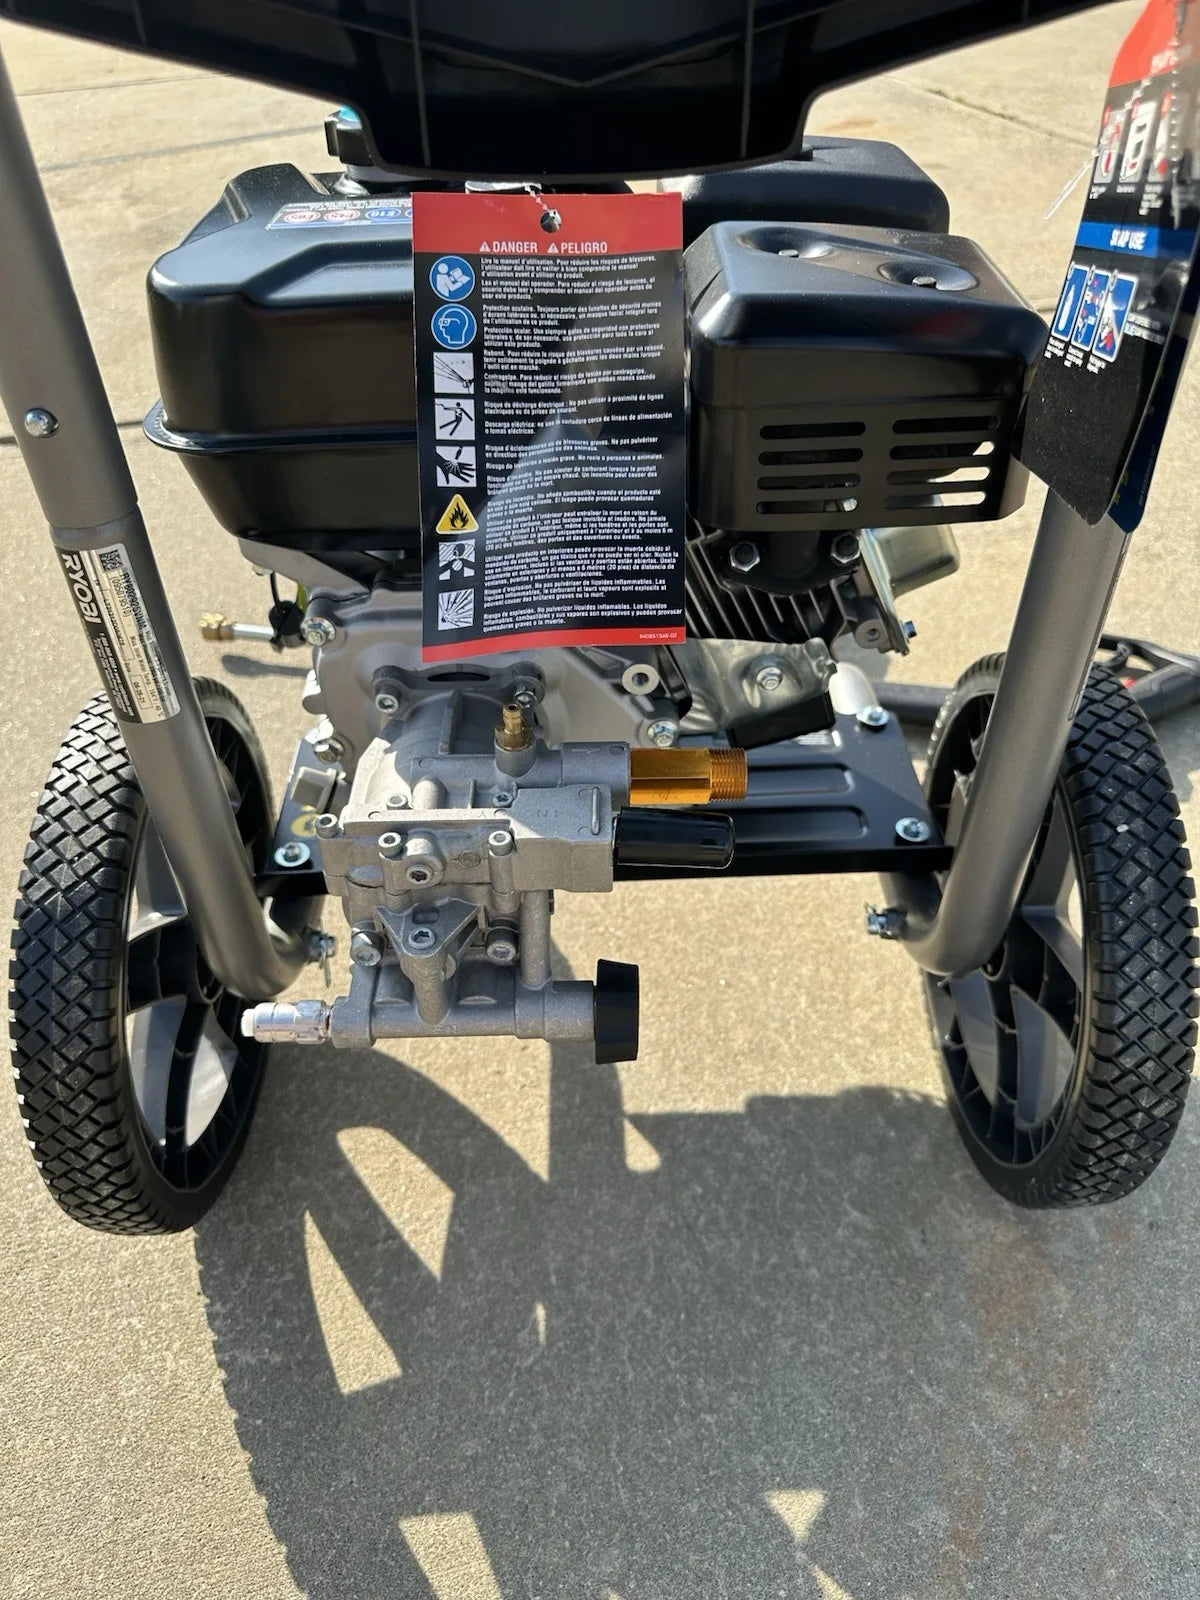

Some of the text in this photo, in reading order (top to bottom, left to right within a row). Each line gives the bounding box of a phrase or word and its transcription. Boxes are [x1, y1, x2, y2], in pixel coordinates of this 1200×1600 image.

[493, 242, 607, 253] DANGER PELIGRO
[1128, 230, 1147, 250] USE
[591, 325, 617, 333] seguridad
[62, 553, 102, 624] RYOBI
